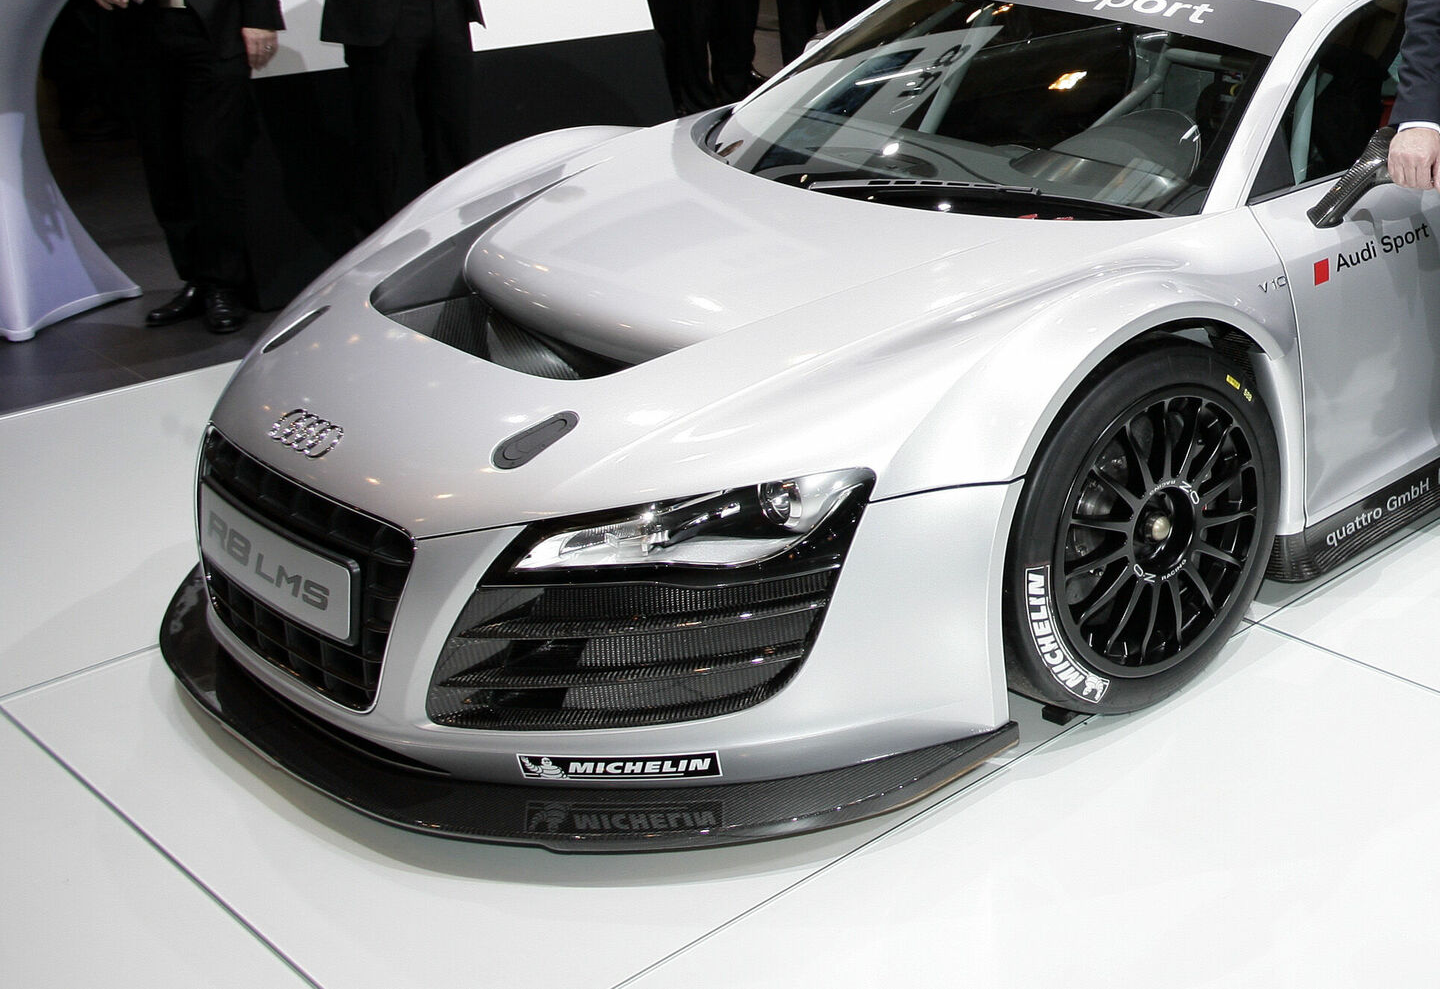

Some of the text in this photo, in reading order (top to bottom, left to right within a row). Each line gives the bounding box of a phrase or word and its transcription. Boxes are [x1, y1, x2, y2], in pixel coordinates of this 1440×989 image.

[1336, 222, 1430, 272] Audi Sport
[1326, 477, 1430, 547] quattro GmbH
[207, 510, 331, 612] R8 LMS
[1161, 558, 1187, 581] RACING
[1027, 572, 1086, 689] MICHELIN
[568, 757, 712, 774] MICHELIN
